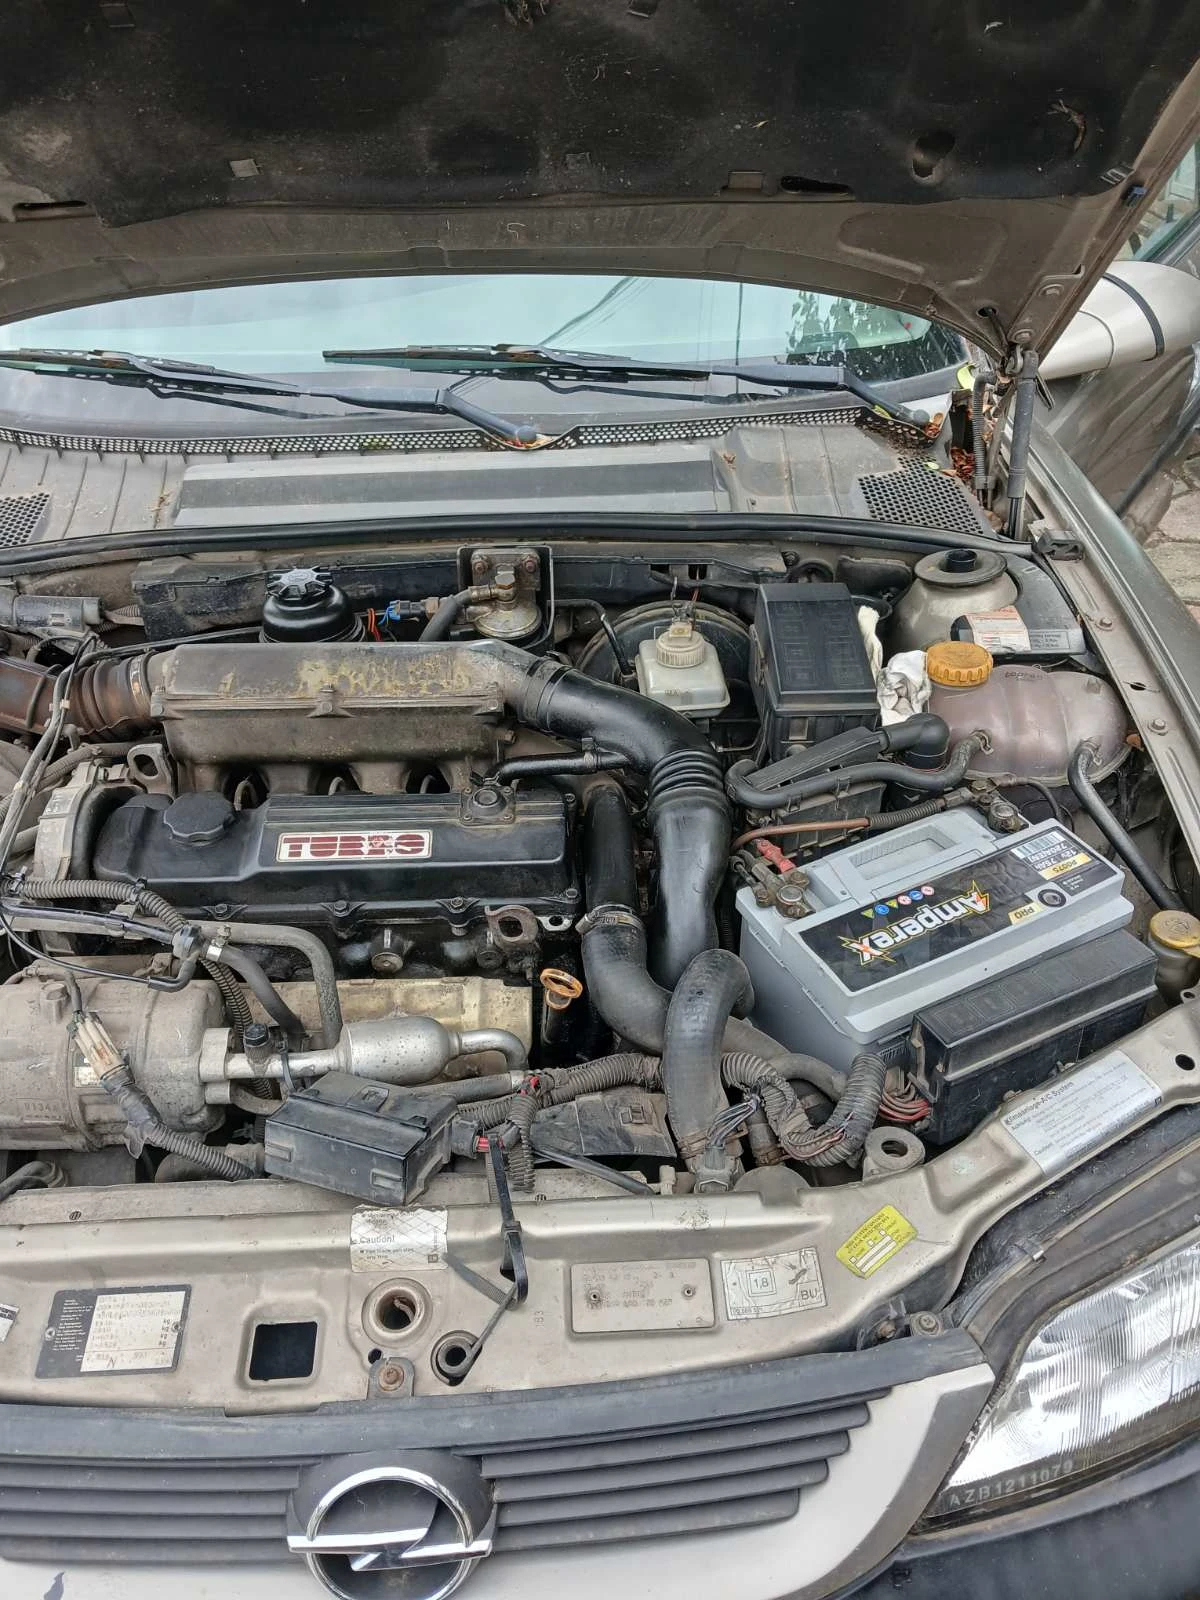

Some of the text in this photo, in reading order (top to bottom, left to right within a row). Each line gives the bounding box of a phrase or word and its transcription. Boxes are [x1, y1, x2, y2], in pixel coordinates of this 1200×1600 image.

[1014, 906, 1036, 920] PRO
[359, 1235, 395, 1245] Caution!
[800, 1288, 818, 1301] BU
